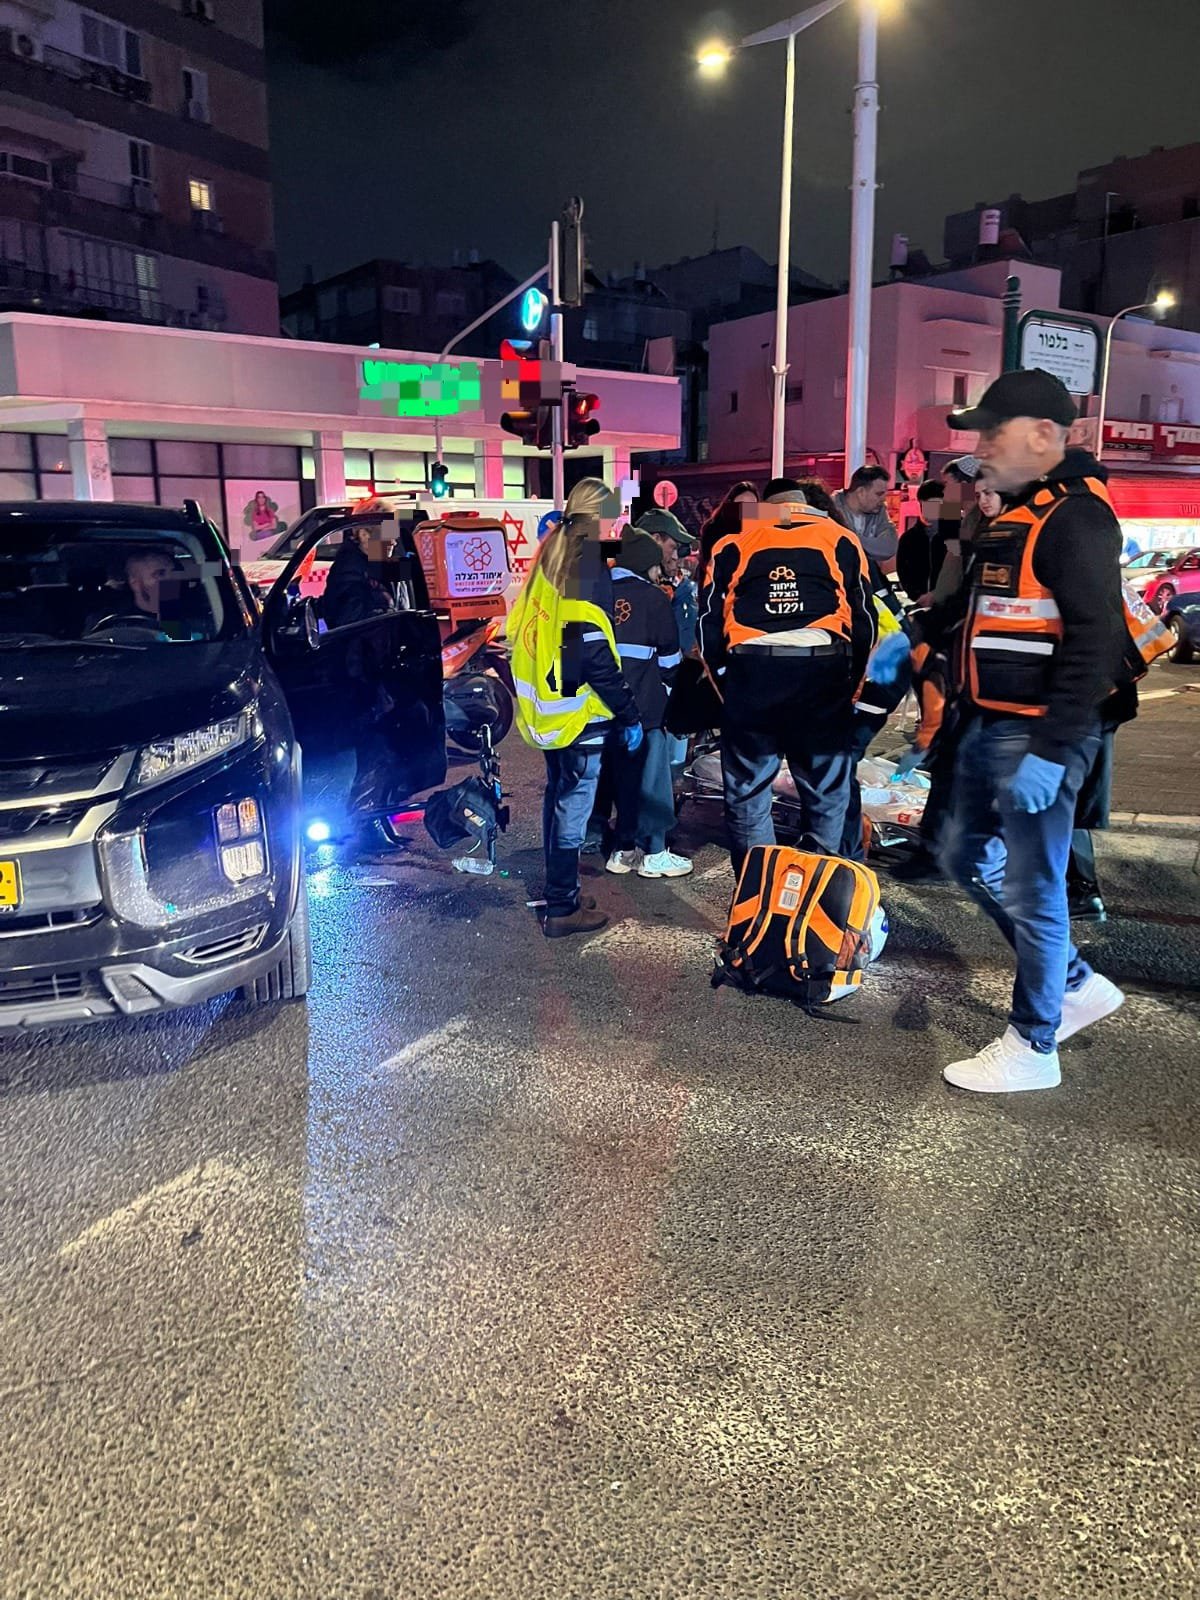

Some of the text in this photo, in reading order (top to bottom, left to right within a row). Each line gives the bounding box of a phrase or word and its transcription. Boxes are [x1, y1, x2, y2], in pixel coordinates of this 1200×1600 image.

[1038, 333, 1068, 350] בלפור
[455, 571, 502, 581] איחוד הצלה
[769, 582, 797, 591] איחוד
[769, 590, 799, 598] הצלה
[778, 601, 804, 614] 1221
